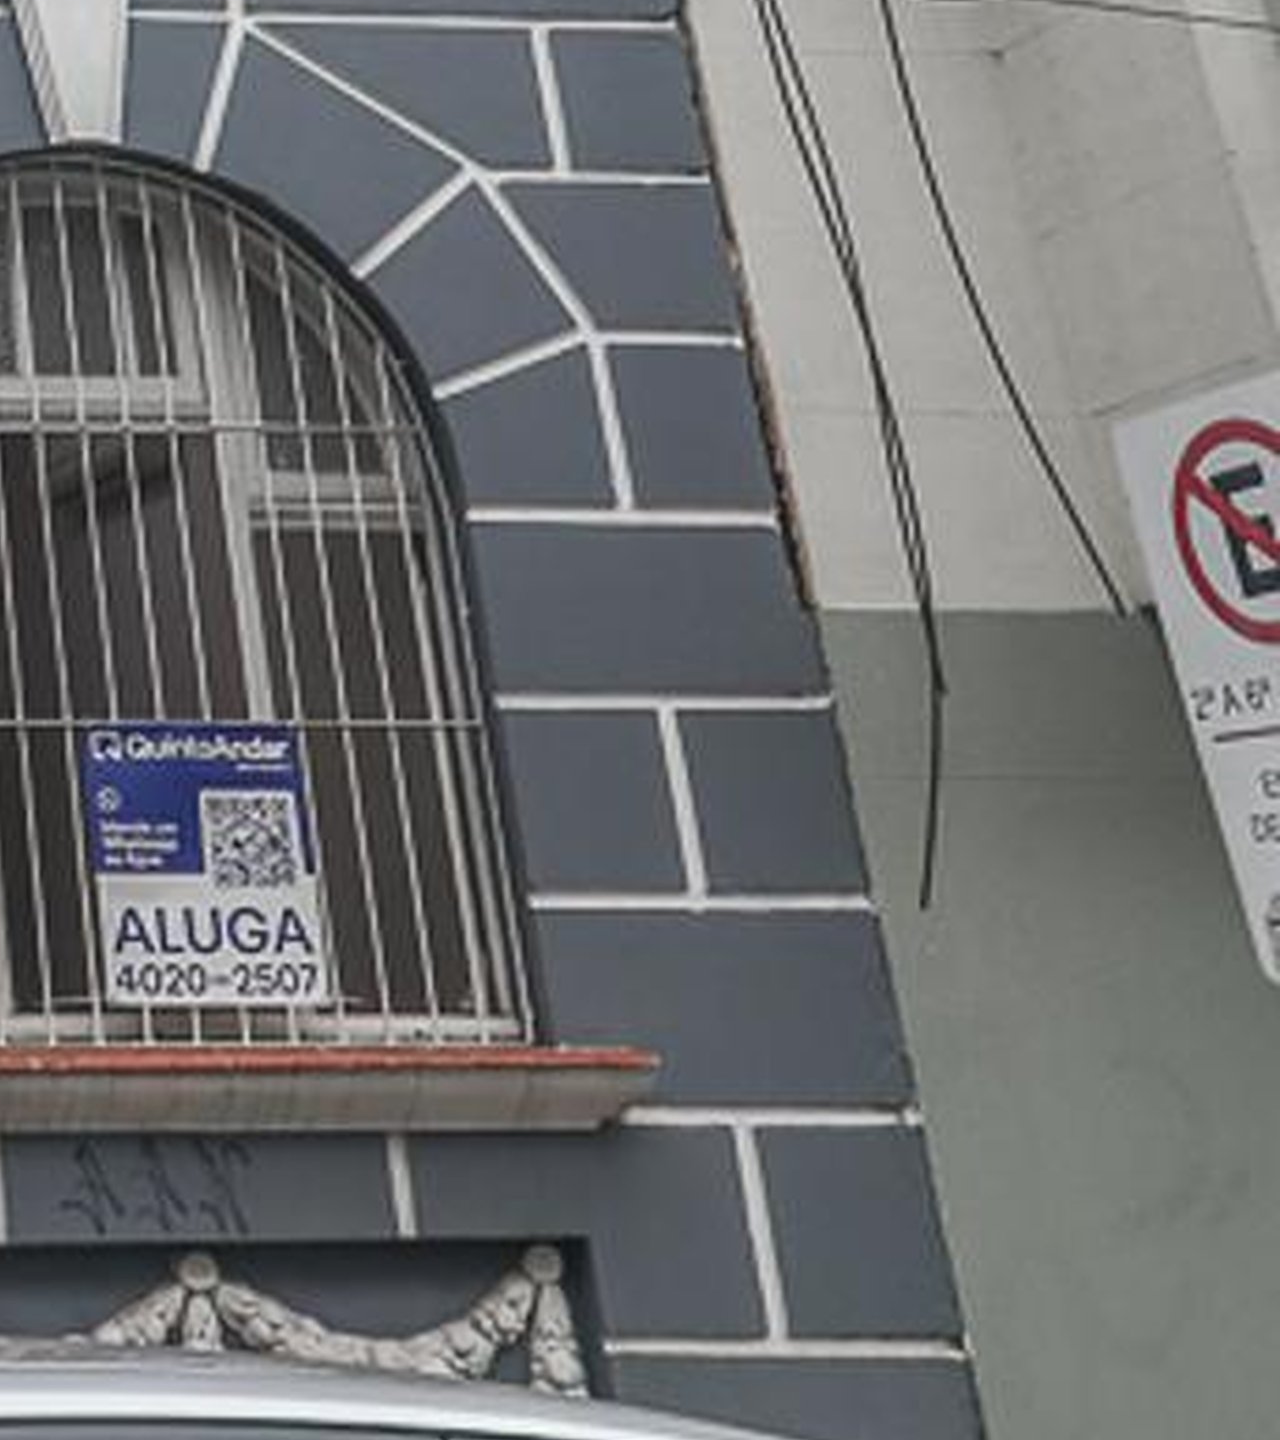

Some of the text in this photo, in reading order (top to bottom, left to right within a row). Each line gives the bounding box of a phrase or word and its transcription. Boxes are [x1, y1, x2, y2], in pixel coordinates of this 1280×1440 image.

[126, 729, 290, 761] QuintoAndar
[114, 905, 315, 955] ALUGA
[115, 962, 318, 997] 4020-2507
